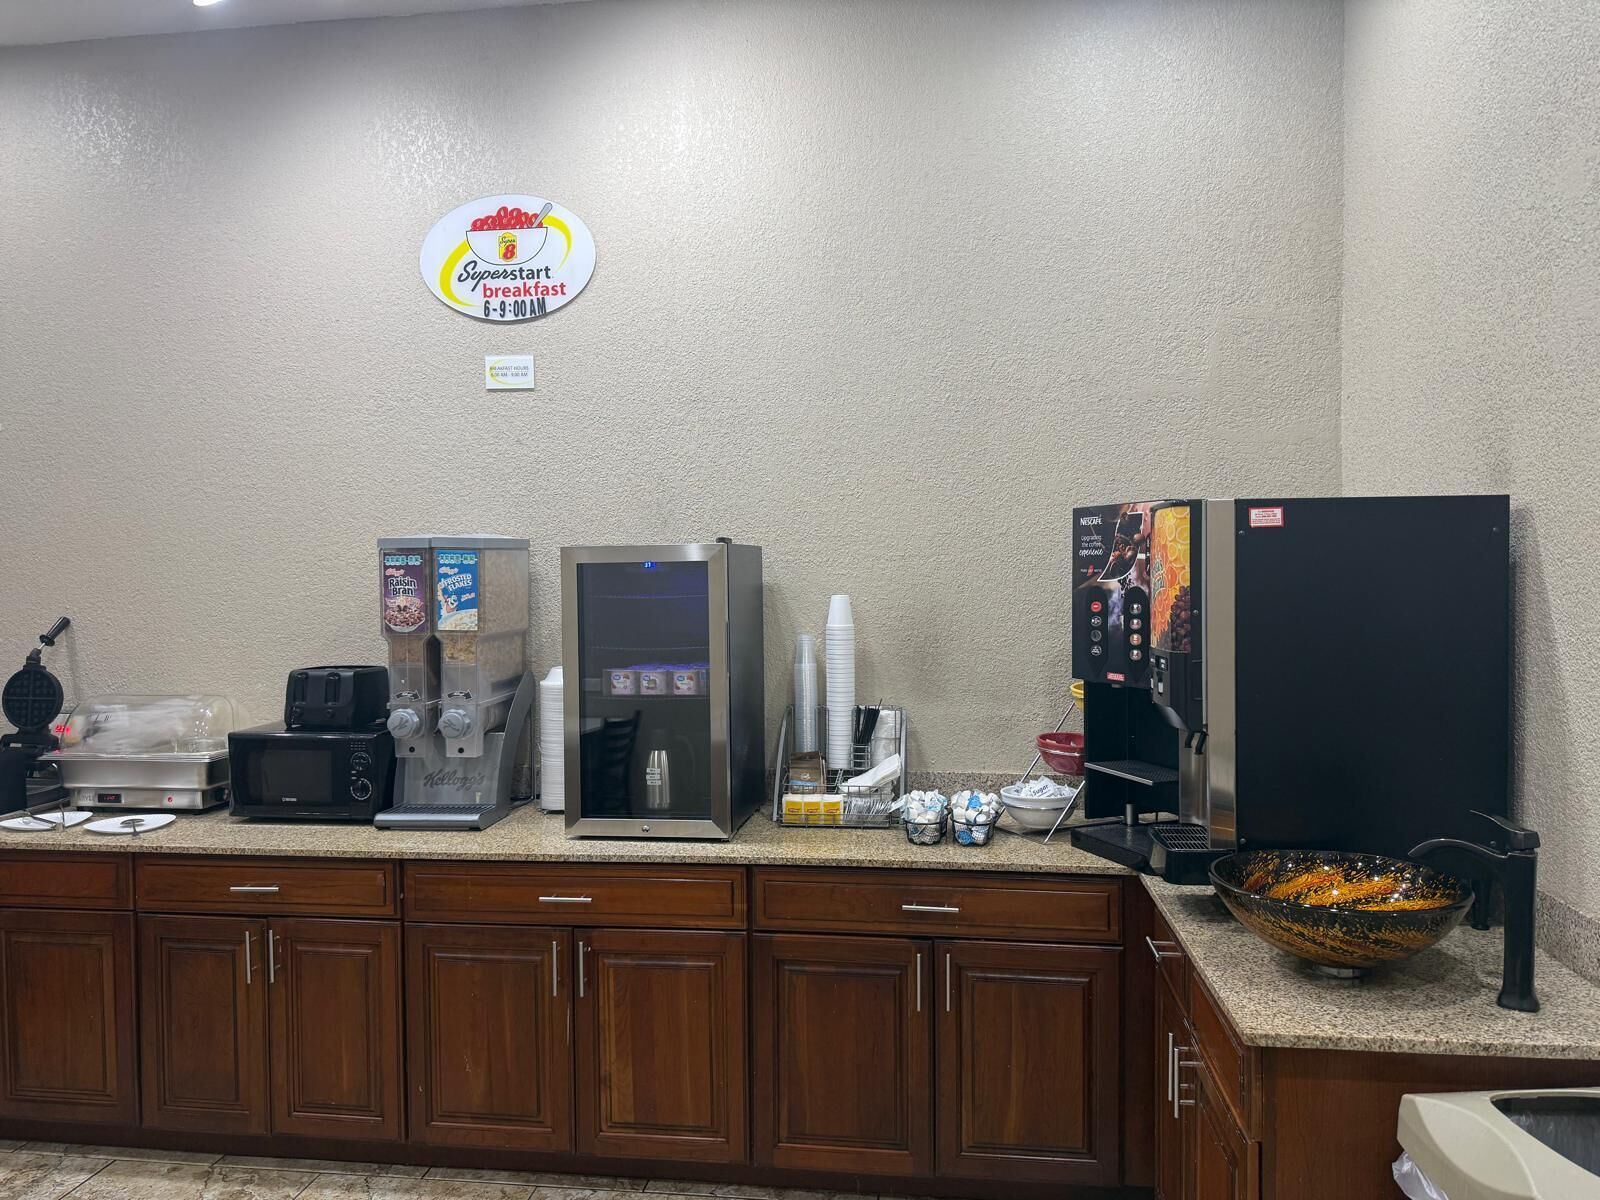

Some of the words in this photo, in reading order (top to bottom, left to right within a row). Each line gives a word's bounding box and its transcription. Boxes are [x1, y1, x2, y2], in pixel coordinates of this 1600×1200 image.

[500, 236, 516, 247] Super
[503, 243, 516, 260] 8
[457, 260, 551, 292] Superstart
[482, 281, 567, 299] breakfast
[529, 296, 547, 317] AM
[1079, 548, 1104, 557] experience
[389, 577, 417, 588] Raisin
[444, 573, 472, 588] FROSTED
[448, 579, 472, 592] FLAKES
[392, 586, 415, 597] Bran
[1032, 784, 1049, 796] Sugar
